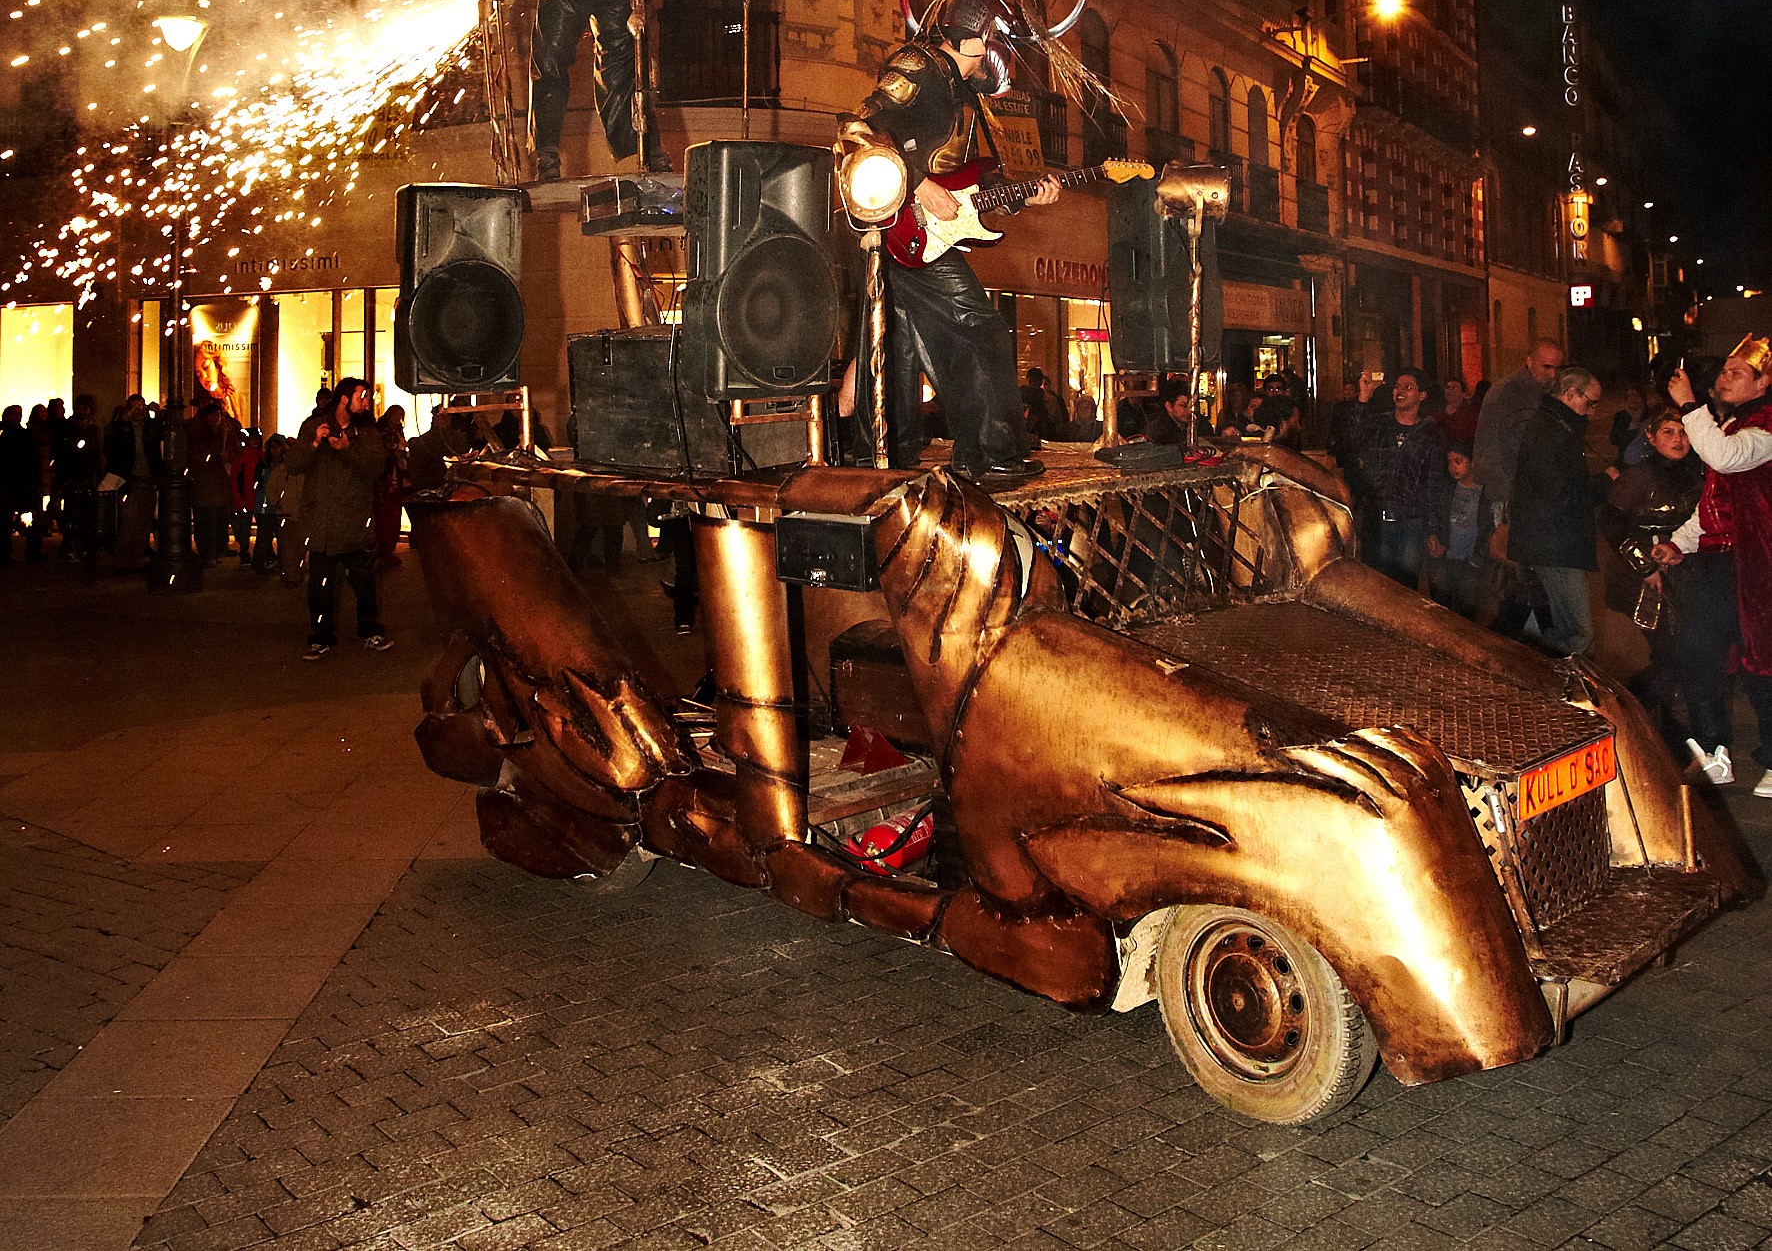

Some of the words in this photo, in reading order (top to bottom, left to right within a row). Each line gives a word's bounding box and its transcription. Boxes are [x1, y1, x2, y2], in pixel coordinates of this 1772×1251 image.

[1567, 133, 1588, 260] PASTOR
[1526, 769, 1563, 814] KULL
[1584, 748, 1609, 785] SAC
